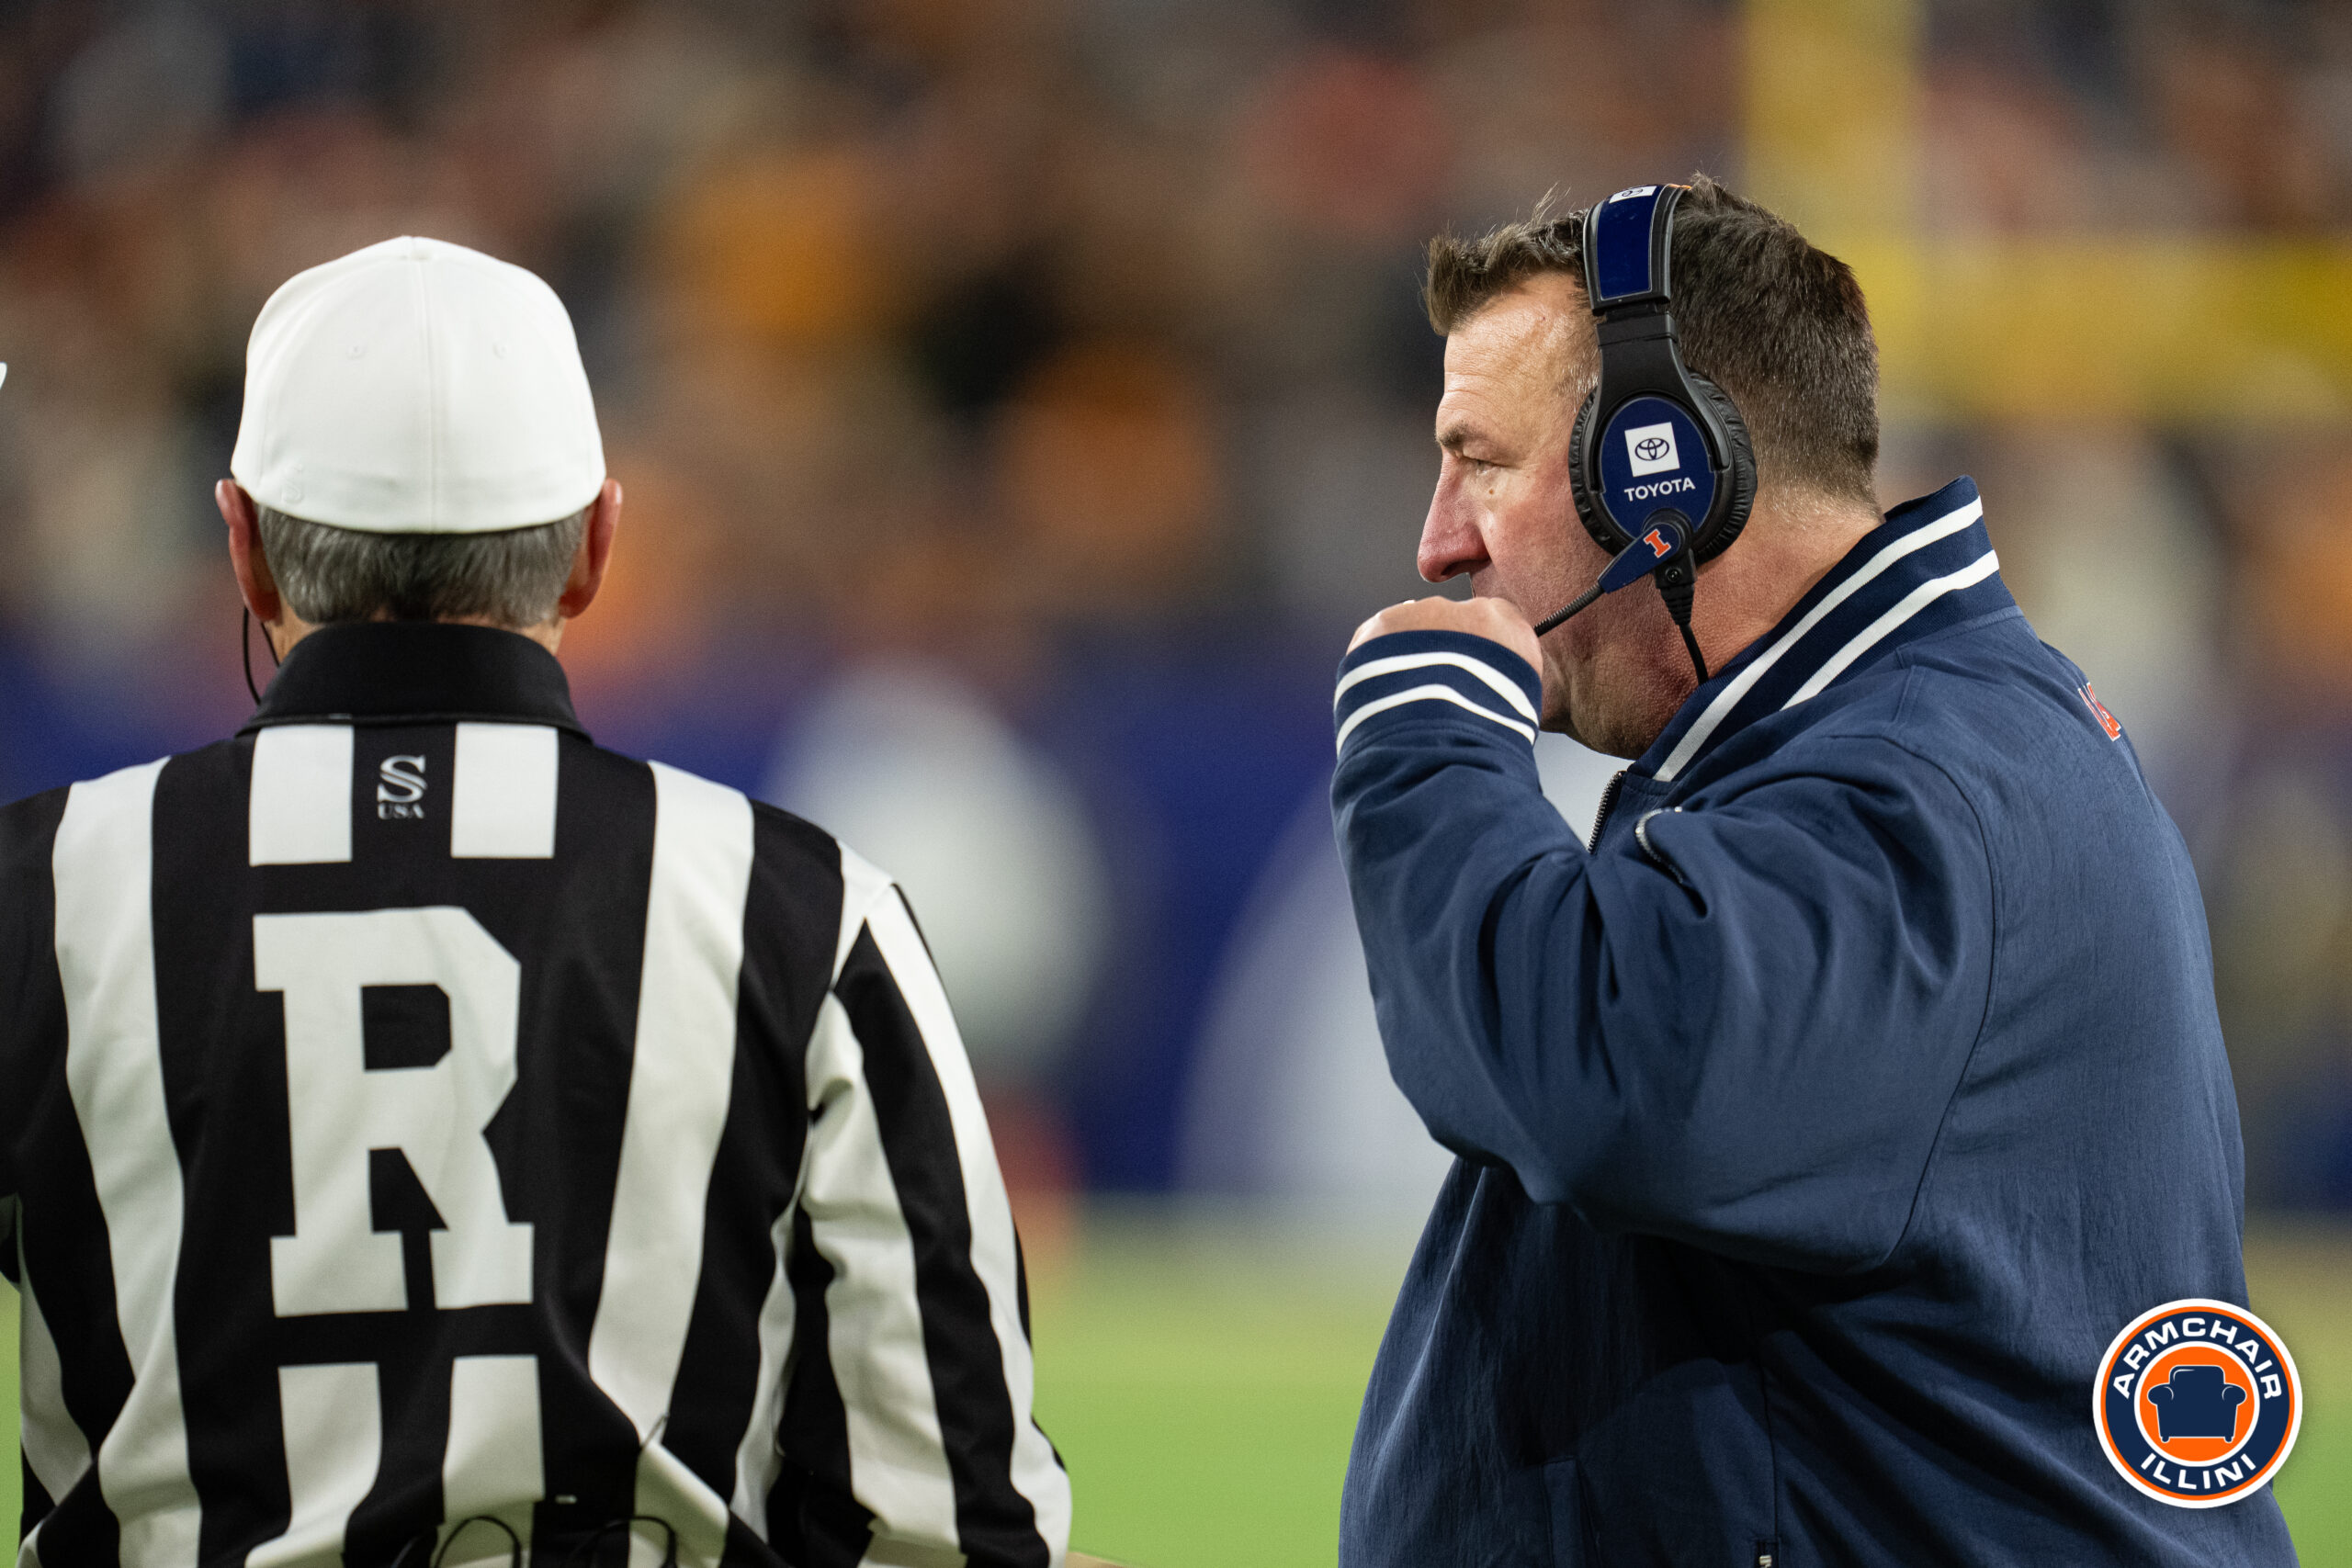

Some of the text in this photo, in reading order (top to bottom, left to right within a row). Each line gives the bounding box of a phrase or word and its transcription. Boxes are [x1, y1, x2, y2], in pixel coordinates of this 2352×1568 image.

[1623, 477, 1696, 502] TOYOTA
[1643, 528, 1671, 558] I
[377, 802, 424, 819] USA
[253, 906, 535, 1317] R
